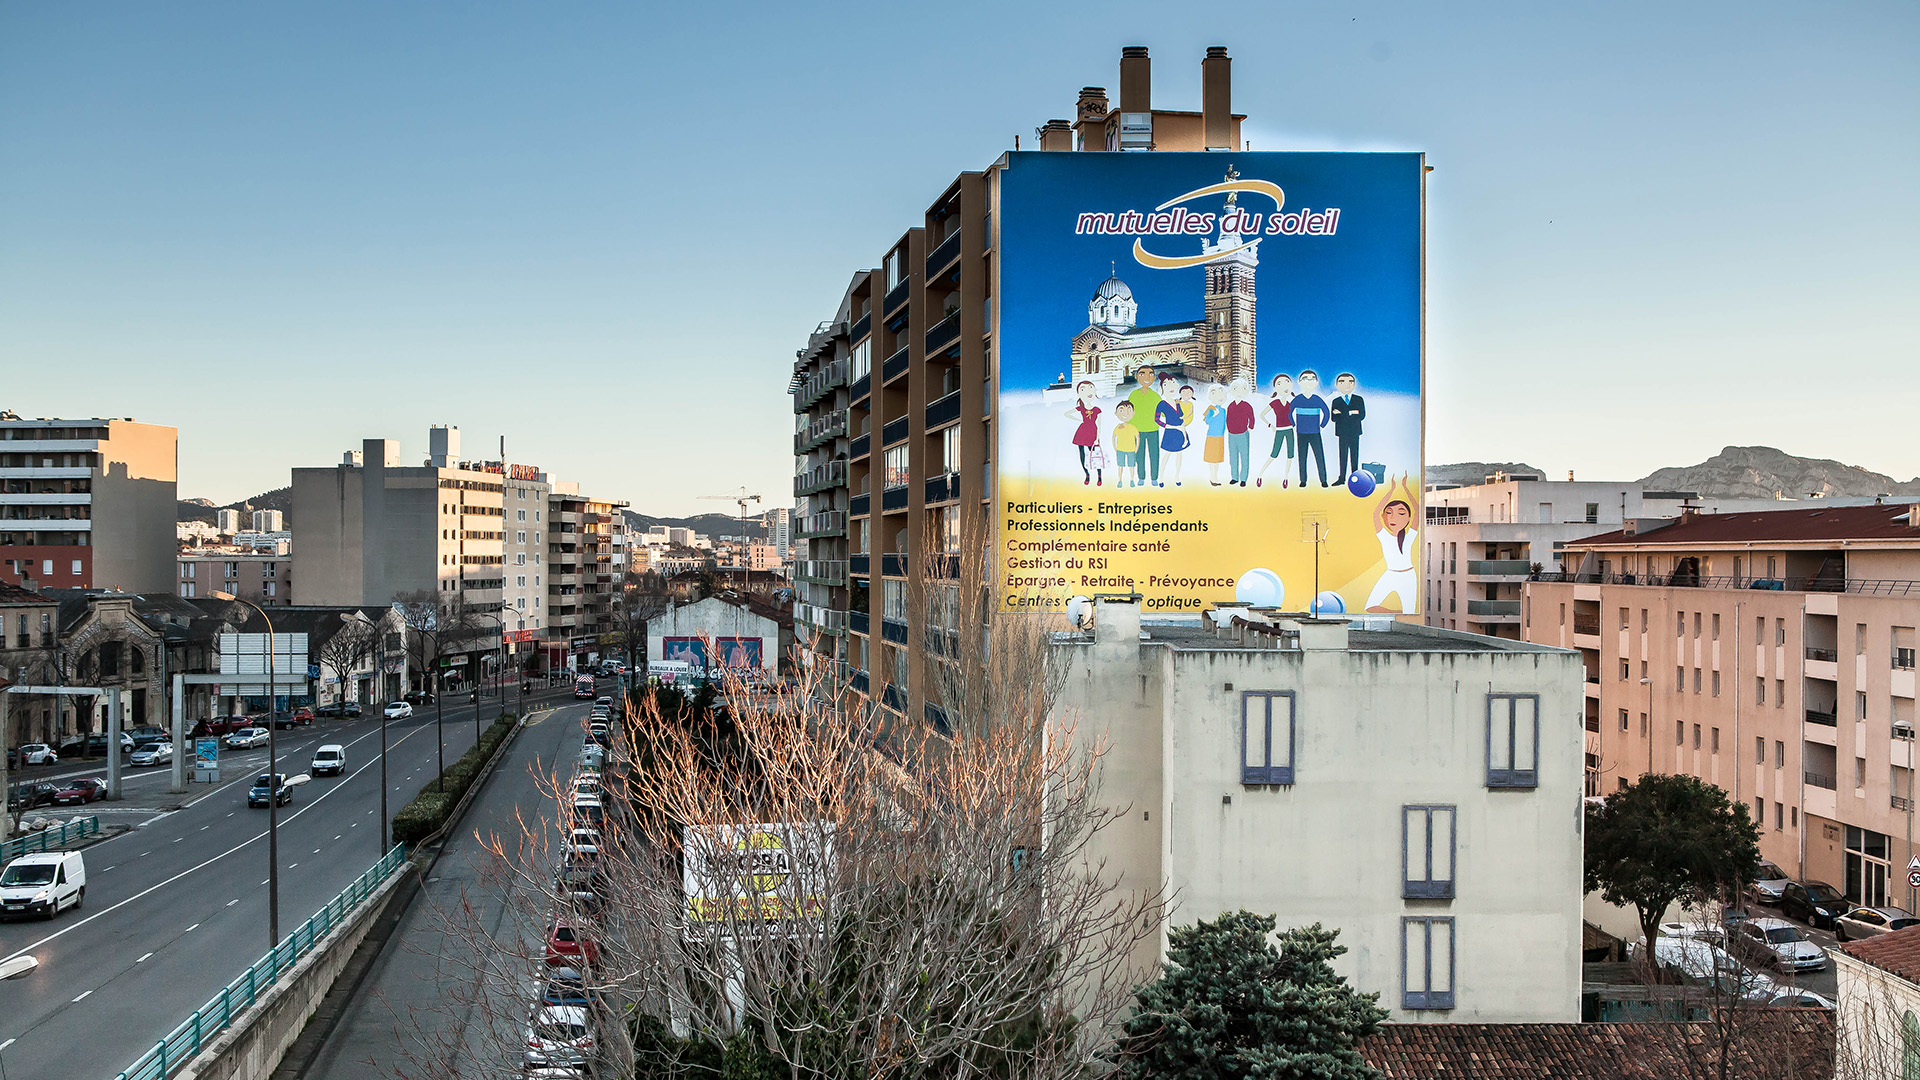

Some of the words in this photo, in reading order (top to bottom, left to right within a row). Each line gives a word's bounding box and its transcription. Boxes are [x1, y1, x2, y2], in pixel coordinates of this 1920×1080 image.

[1075, 207, 1215, 235] mutuelles
[1221, 208, 1263, 235] du
[1266, 207, 1341, 236] soleil
[1007, 501, 1083, 514] Particuliers
[1098, 502, 1173, 516] Entreprises
[1007, 519, 1105, 532] Professionnels
[1110, 519, 1209, 534] Indépendants
[1007, 539, 1128, 554] Complémentaire
[1132, 539, 1170, 552] santé
[1007, 557, 1060, 569] Gestion
[1065, 557, 1083, 569] du
[1088, 557, 1108, 569] RSI
[1081, 574, 1135, 587] Retraite
[1149, 574, 1235, 589] Prévoyance
[1006, 594, 1061, 607] Centres
[1147, 596, 1202, 610] optique
